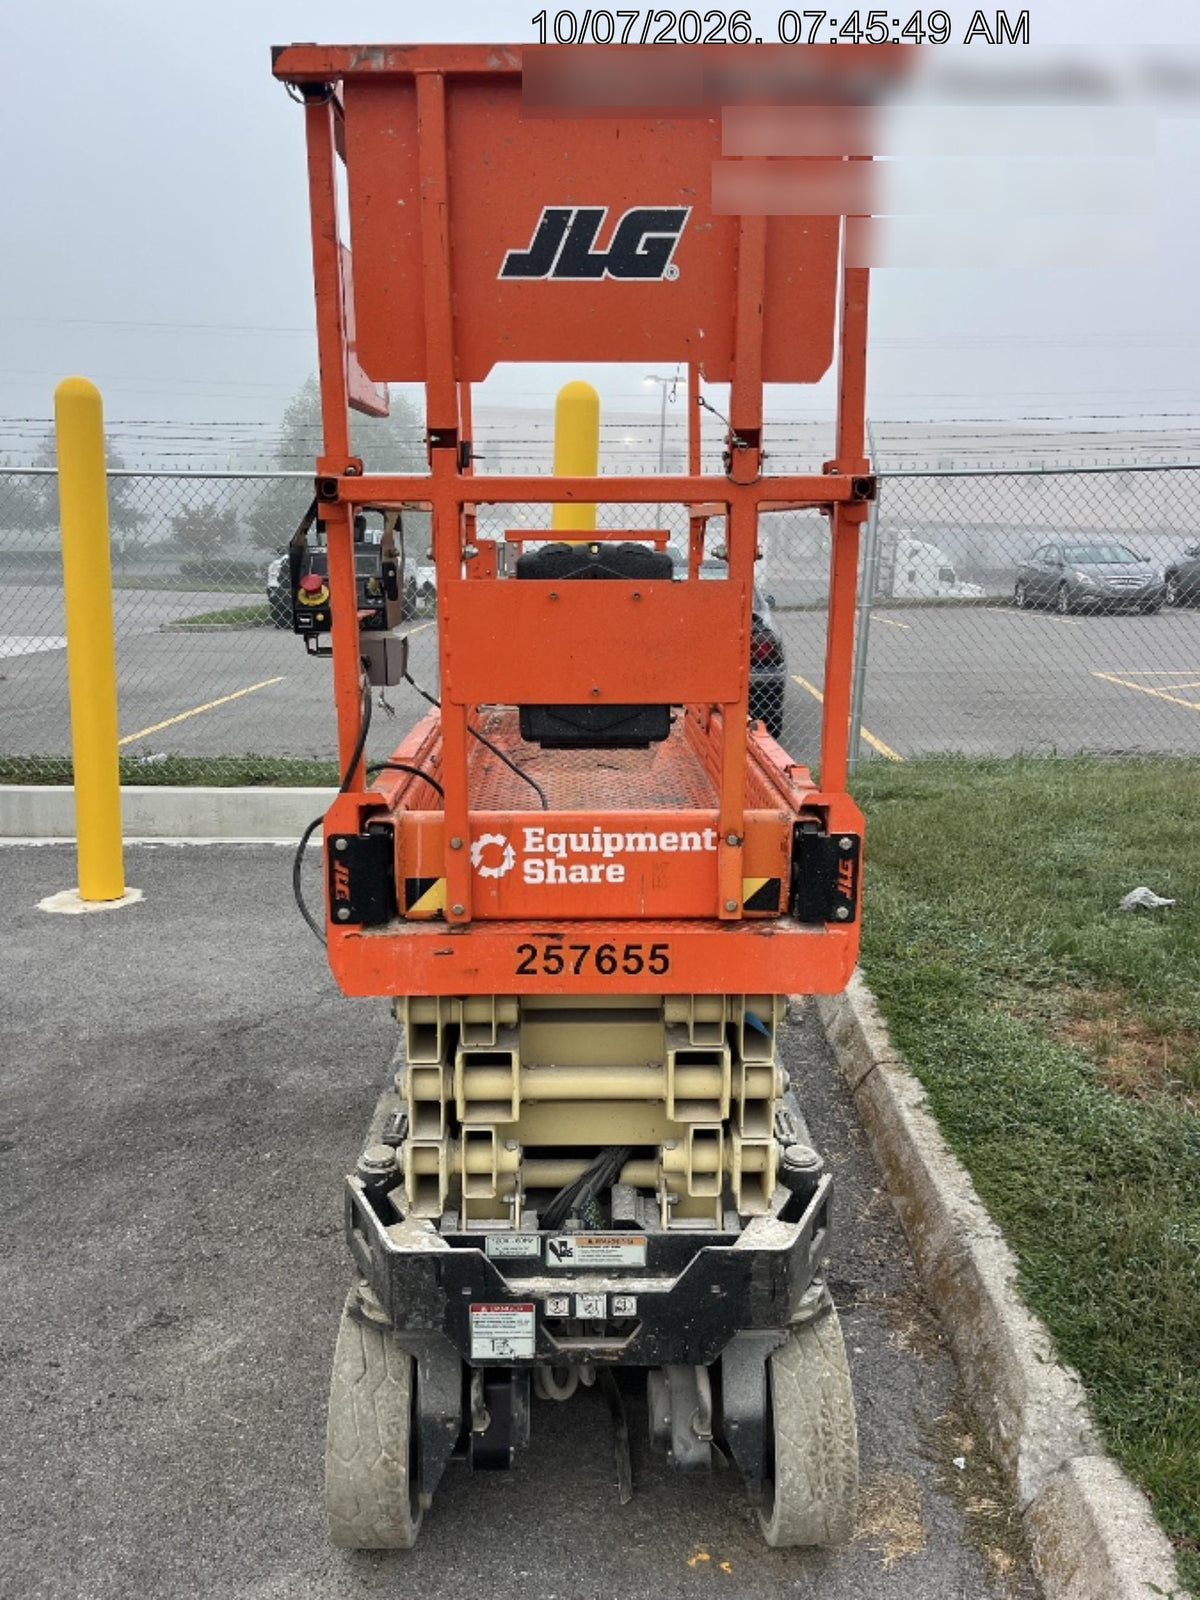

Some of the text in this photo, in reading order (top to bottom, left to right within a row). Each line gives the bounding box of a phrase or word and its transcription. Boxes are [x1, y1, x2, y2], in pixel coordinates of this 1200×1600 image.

[497, 206, 693, 281] JLG
[522, 826, 718, 858] Equipment
[334, 860, 351, 901] JLG
[523, 858, 626, 884] Share
[837, 859, 853, 900] JLG
[515, 943, 670, 975] 257655
